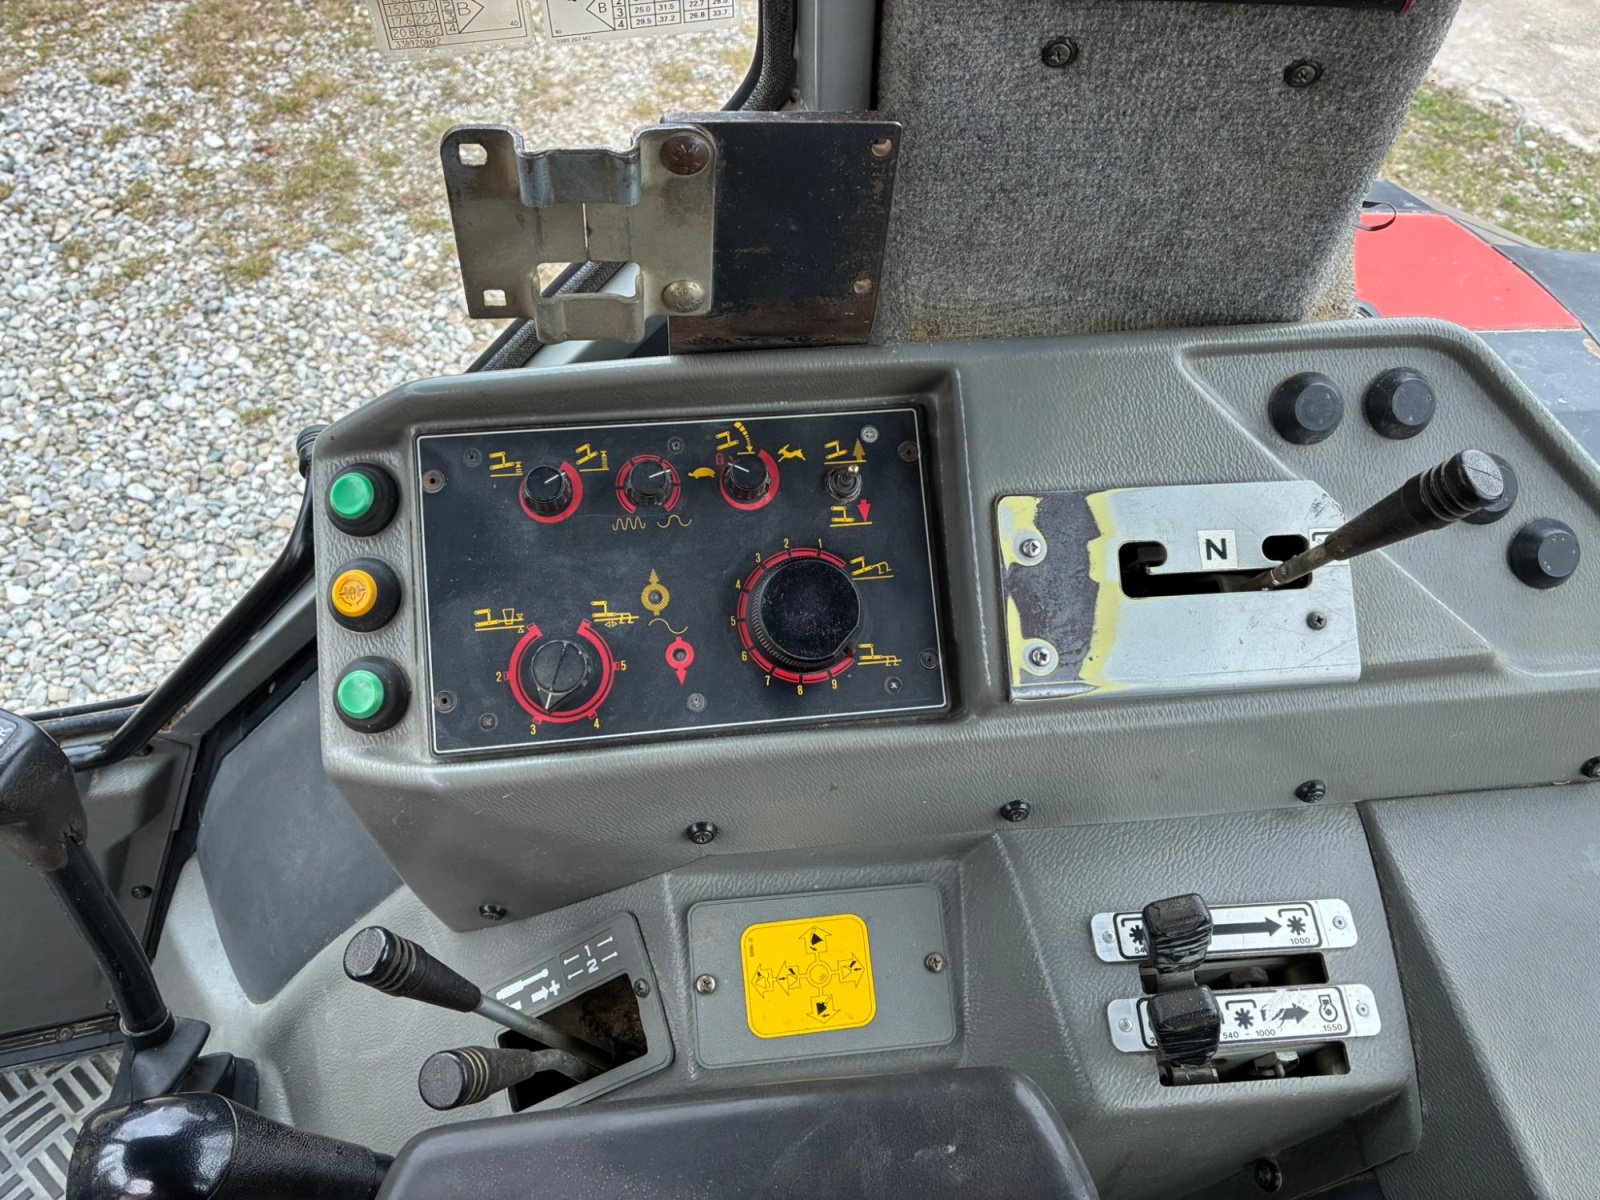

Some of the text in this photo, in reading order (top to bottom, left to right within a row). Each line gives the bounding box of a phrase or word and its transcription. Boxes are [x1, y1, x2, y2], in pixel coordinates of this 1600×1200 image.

[413, 2, 436, 12] 19.0
[456, 2, 471, 16] B
[598, 2, 607, 14] B
[616, 4, 675, 17] 3 25.0 31.5
[690, 9, 728, 20] 26.8 33.7
[617, 15, 676, 28] 4 29.5 37.2
[392, 23, 457, 39] 20.8 26.2 4
[783, 538, 789, 549] 2
[818, 538, 822, 548] 1
[1205, 538, 1227, 561] N
[755, 552, 761, 563] 3
[735, 579, 741, 589] 4
[730, 616, 736, 626] 5
[741, 651, 747, 661] 6
[620, 660, 627, 671] 5
[496, 671, 502, 682] 2
[765, 675, 771, 686] 7
[831, 679, 838, 689] 9
[797, 685, 803, 696] 8
[593, 718, 600, 729] 4
[530, 724, 536, 735] 3
[1290, 936, 1311, 945] 1000
[584, 944, 591, 957] 1
[586, 958, 599, 973] 2
[1323, 1023, 1343, 1032] 1550
[1222, 1031, 1239, 1039] 540
[1255, 1028, 1276, 1037] 1000
